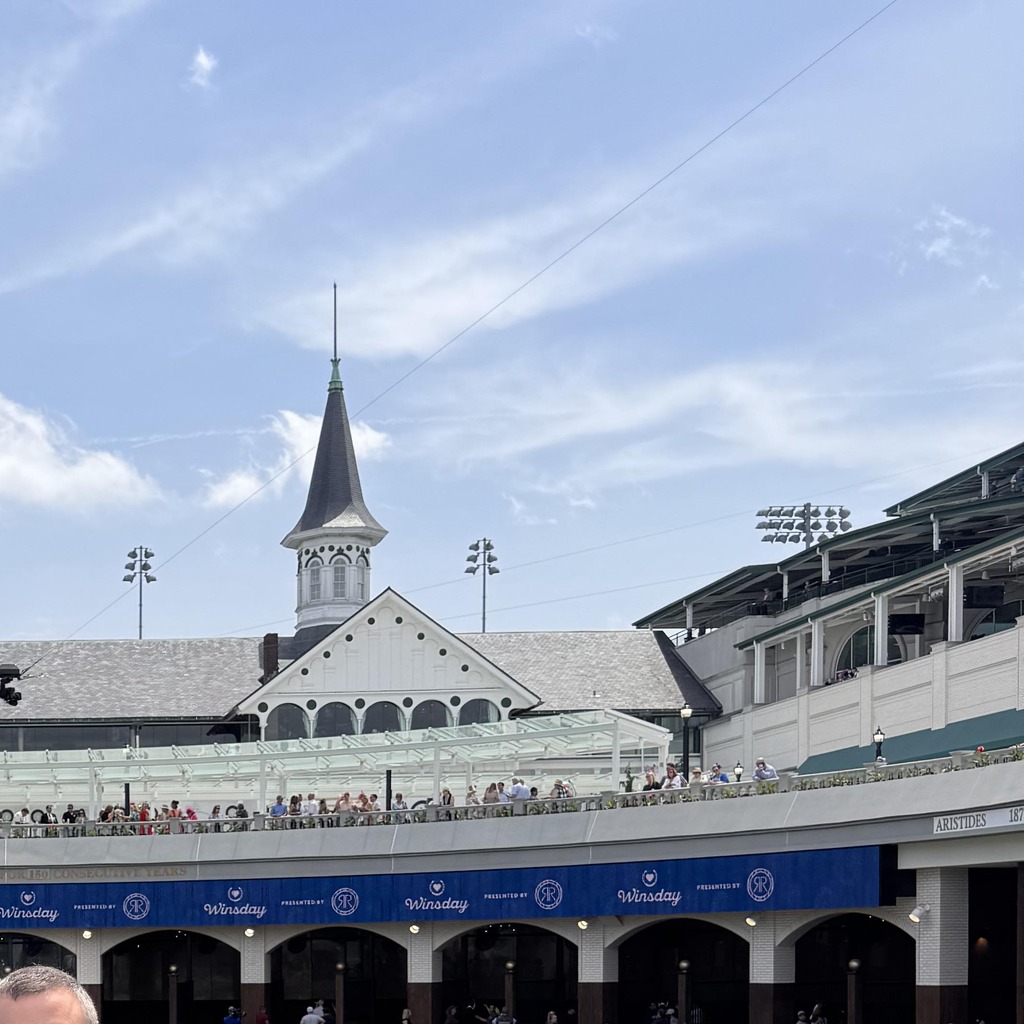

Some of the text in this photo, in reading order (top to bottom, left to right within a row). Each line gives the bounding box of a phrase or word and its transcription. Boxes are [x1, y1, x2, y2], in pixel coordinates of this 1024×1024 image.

[936, 813, 987, 832] ARISTIDES
[0, 870, 25, 880] FOR
[51, 868, 140, 879] CONSECUTIVE
[145, 867, 187, 877] YEARS
[404, 897, 469, 914] Winsday
[617, 888, 683, 907] Winsday
[203, 903, 267, 919] Winsday
